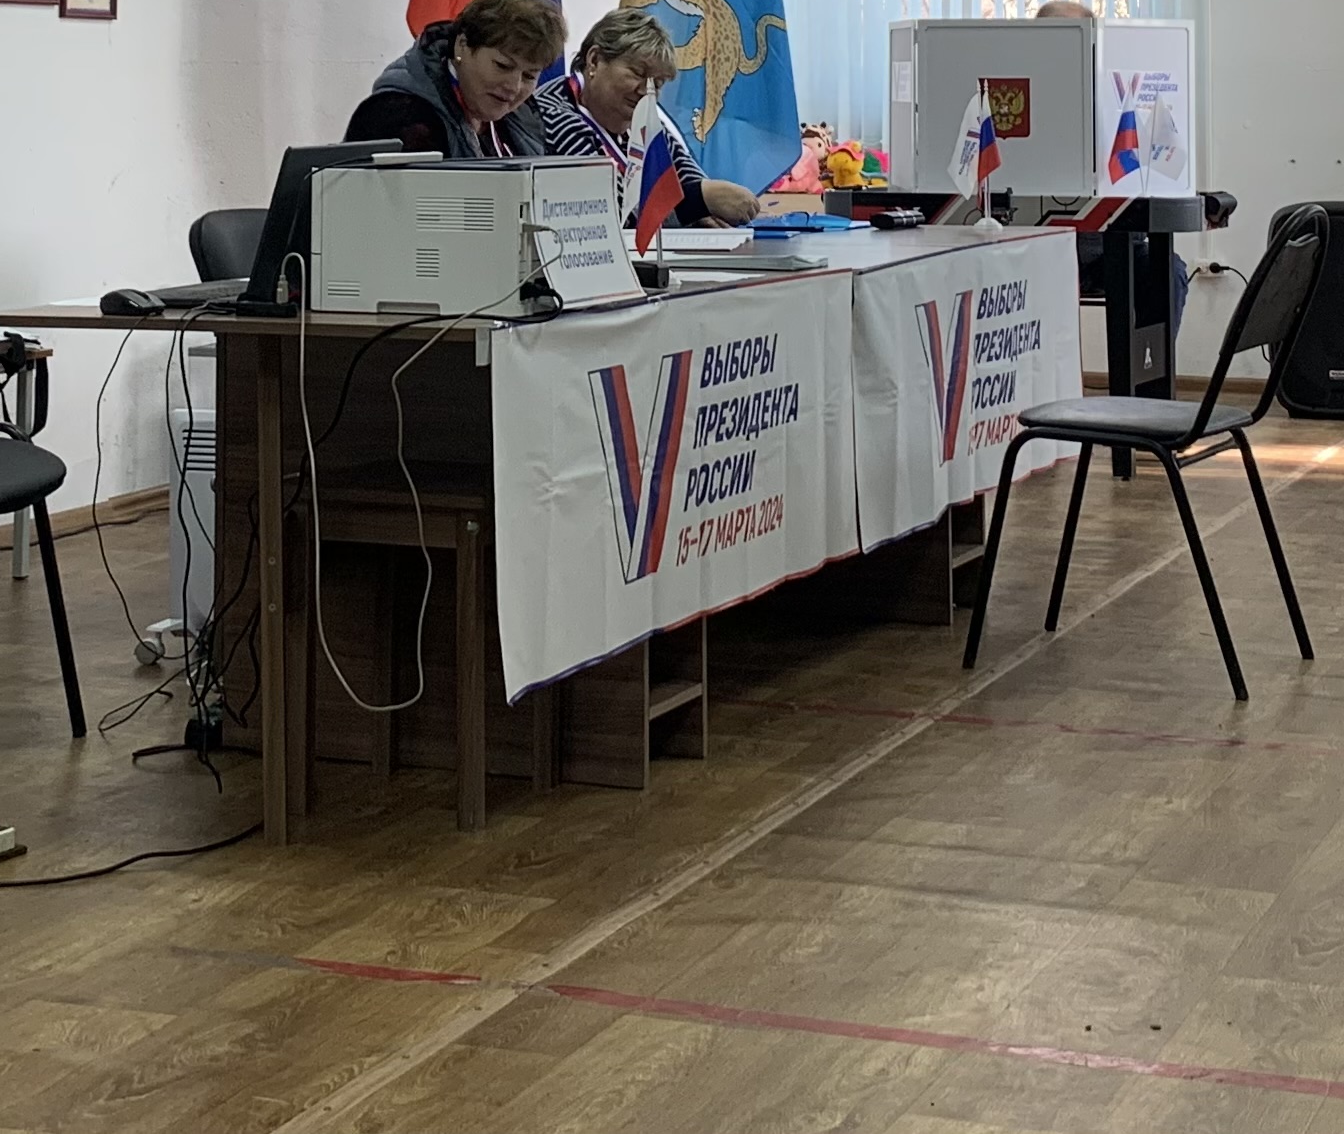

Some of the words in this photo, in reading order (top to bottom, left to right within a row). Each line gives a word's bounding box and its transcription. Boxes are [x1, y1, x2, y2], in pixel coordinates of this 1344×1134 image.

[1137, 93, 1158, 102] РОССИ
[542, 198, 609, 221] Дистанционное
[553, 224, 608, 246] электронное
[976, 279, 1028, 320] ВЫБОРЫ
[700, 333, 778, 389] ВЫБОРЫ
[973, 319, 1041, 366] ПРЕЗИДЕНТА
[693, 382, 799, 449] ПРЕЗИДЕНТА
[683, 449, 756, 512] РОССИИ
[715, 503, 756, 553] МАРТА
[757, 494, 784, 537] 2024
